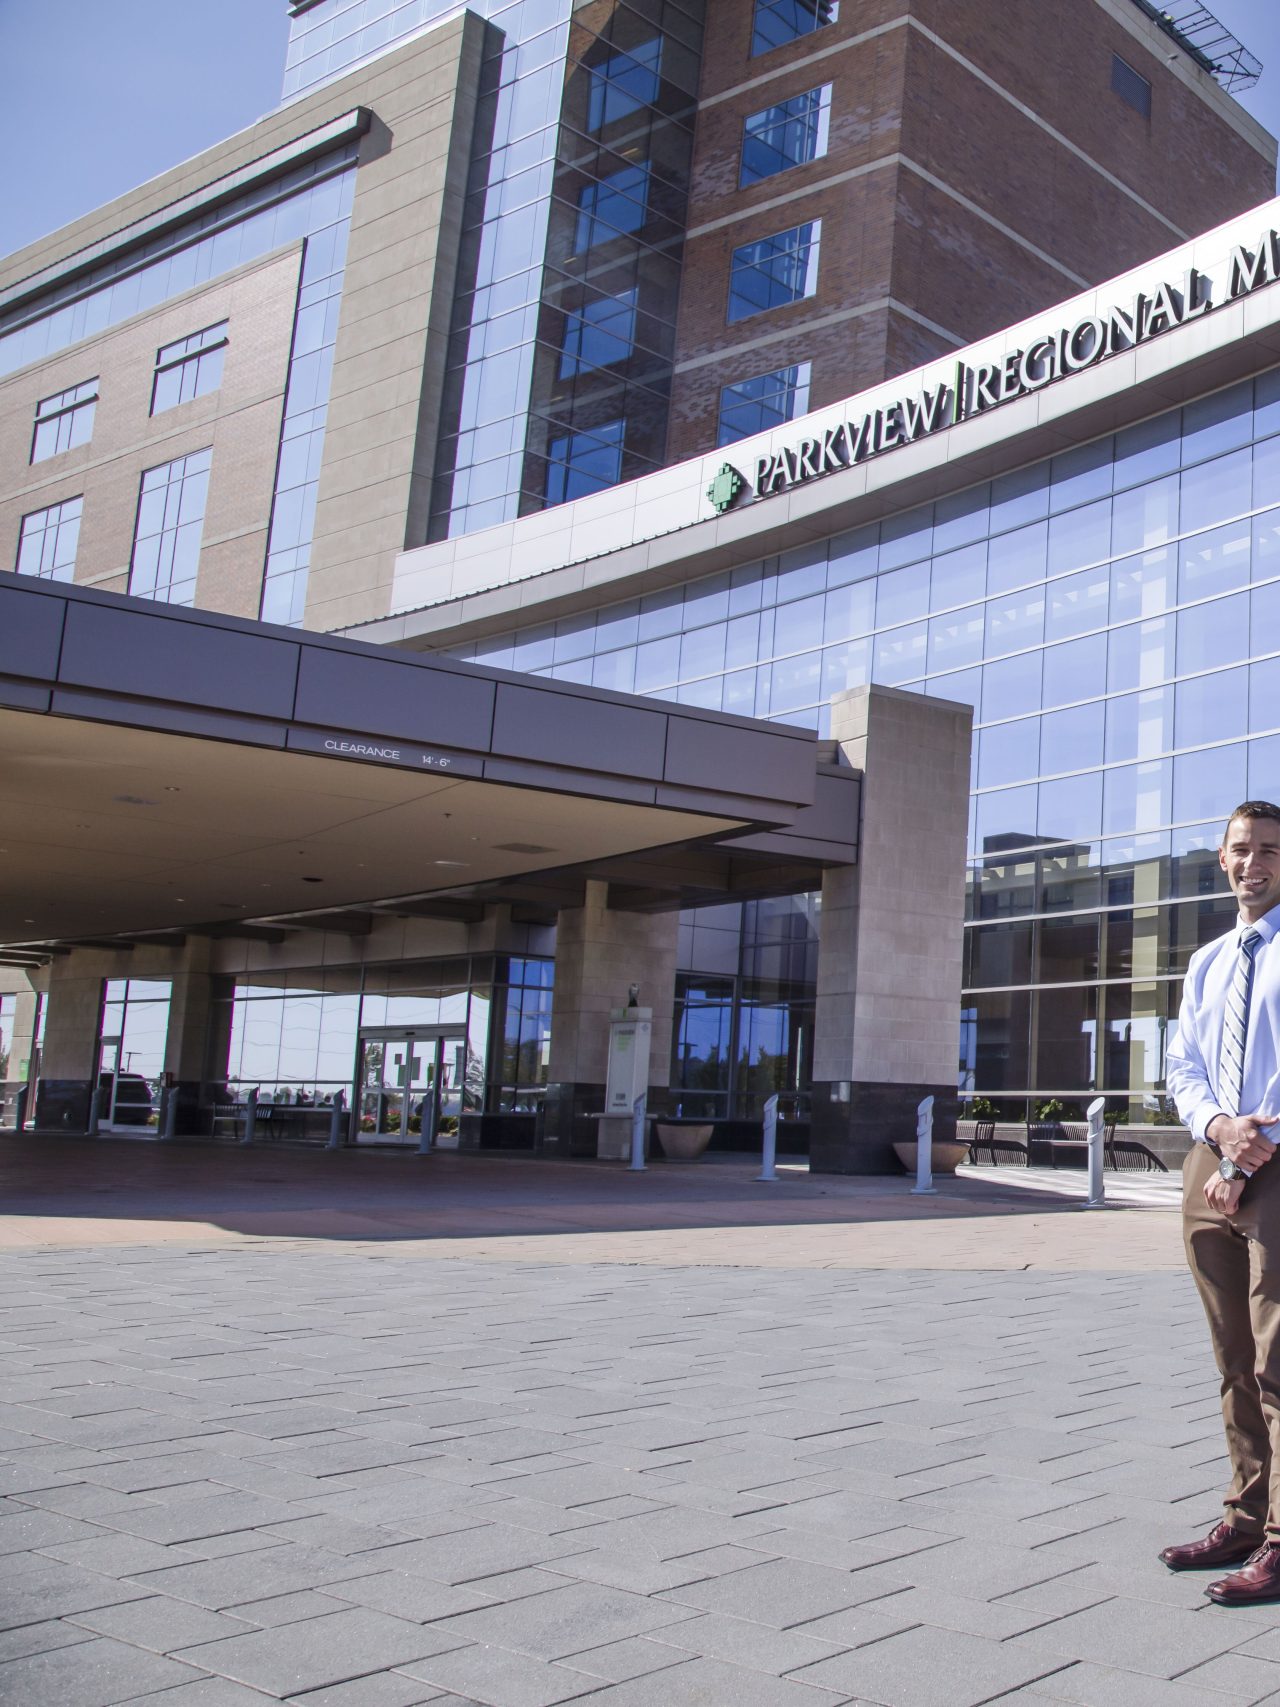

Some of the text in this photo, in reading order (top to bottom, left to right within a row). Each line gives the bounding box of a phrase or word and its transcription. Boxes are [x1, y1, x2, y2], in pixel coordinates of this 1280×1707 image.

[752, 383, 946, 501] PARKVIEW
[968, 267, 1211, 413] REGIONAL
[324, 740, 400, 760] CLEARANCE
